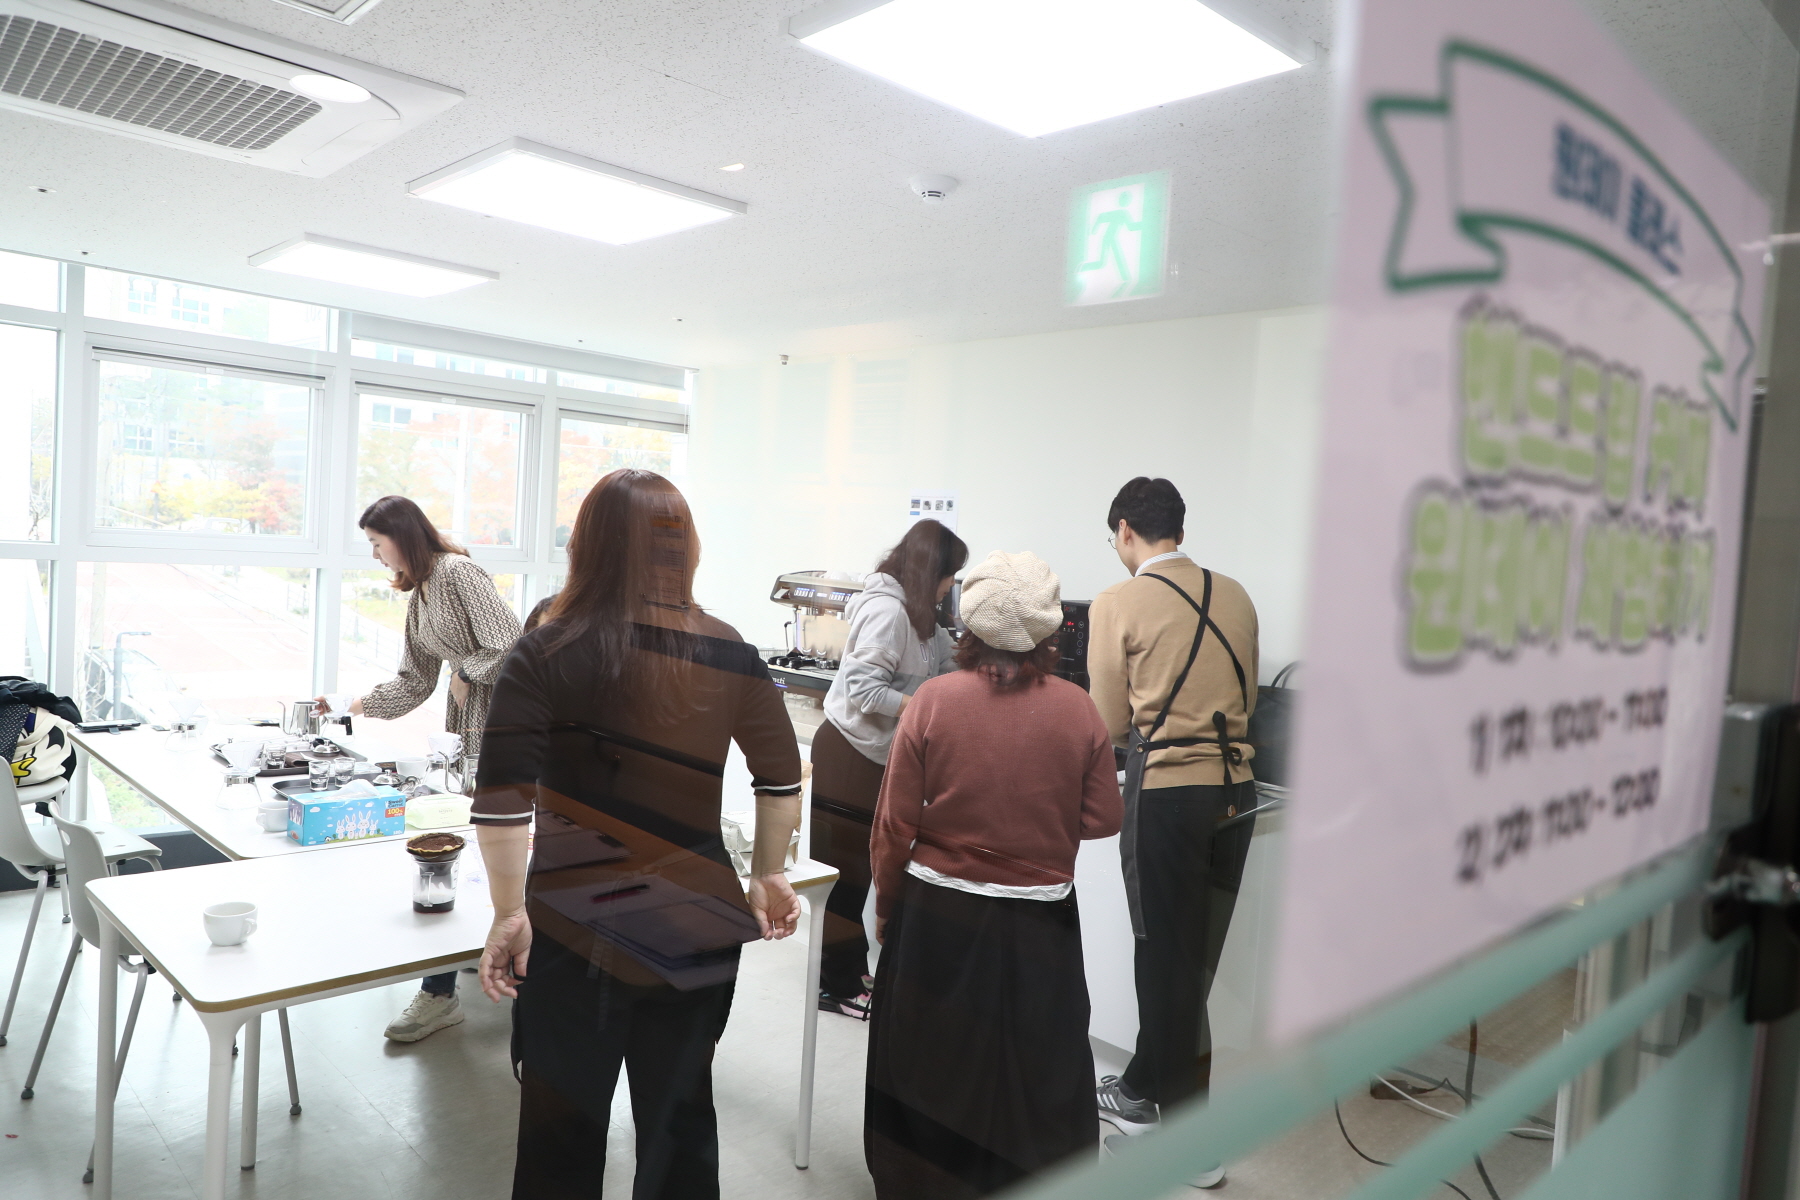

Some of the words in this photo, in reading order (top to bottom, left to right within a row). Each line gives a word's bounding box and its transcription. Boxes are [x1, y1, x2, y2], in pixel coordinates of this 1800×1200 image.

[1458, 298, 1643, 508] 핸드드립
[1646, 386, 1711, 512] 커피
[1403, 487, 1570, 664] 원데이
